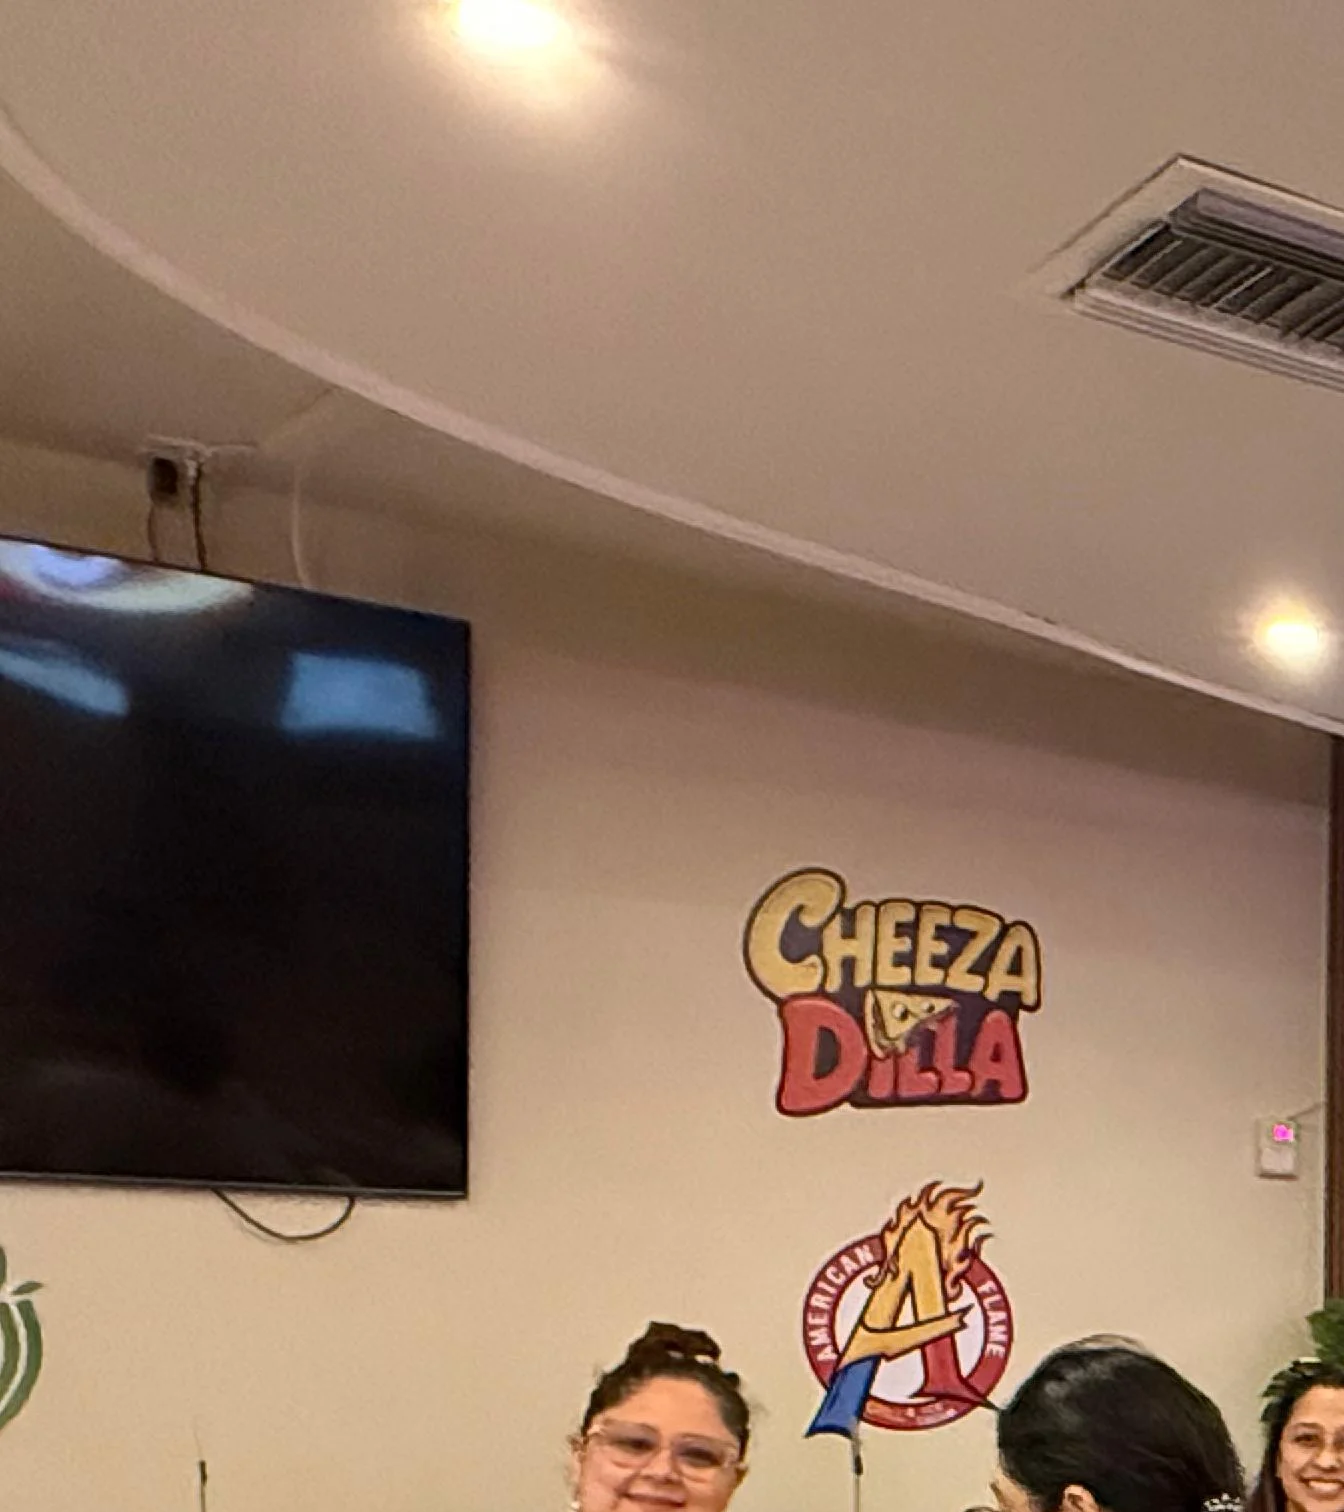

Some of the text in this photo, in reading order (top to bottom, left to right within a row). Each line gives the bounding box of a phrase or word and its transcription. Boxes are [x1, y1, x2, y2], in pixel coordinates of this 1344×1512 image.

[745, 869, 1040, 1008] CHEEZA
[806, 1243, 876, 1363] AMERICAN
[976, 1280, 1009, 1360] FLAME
